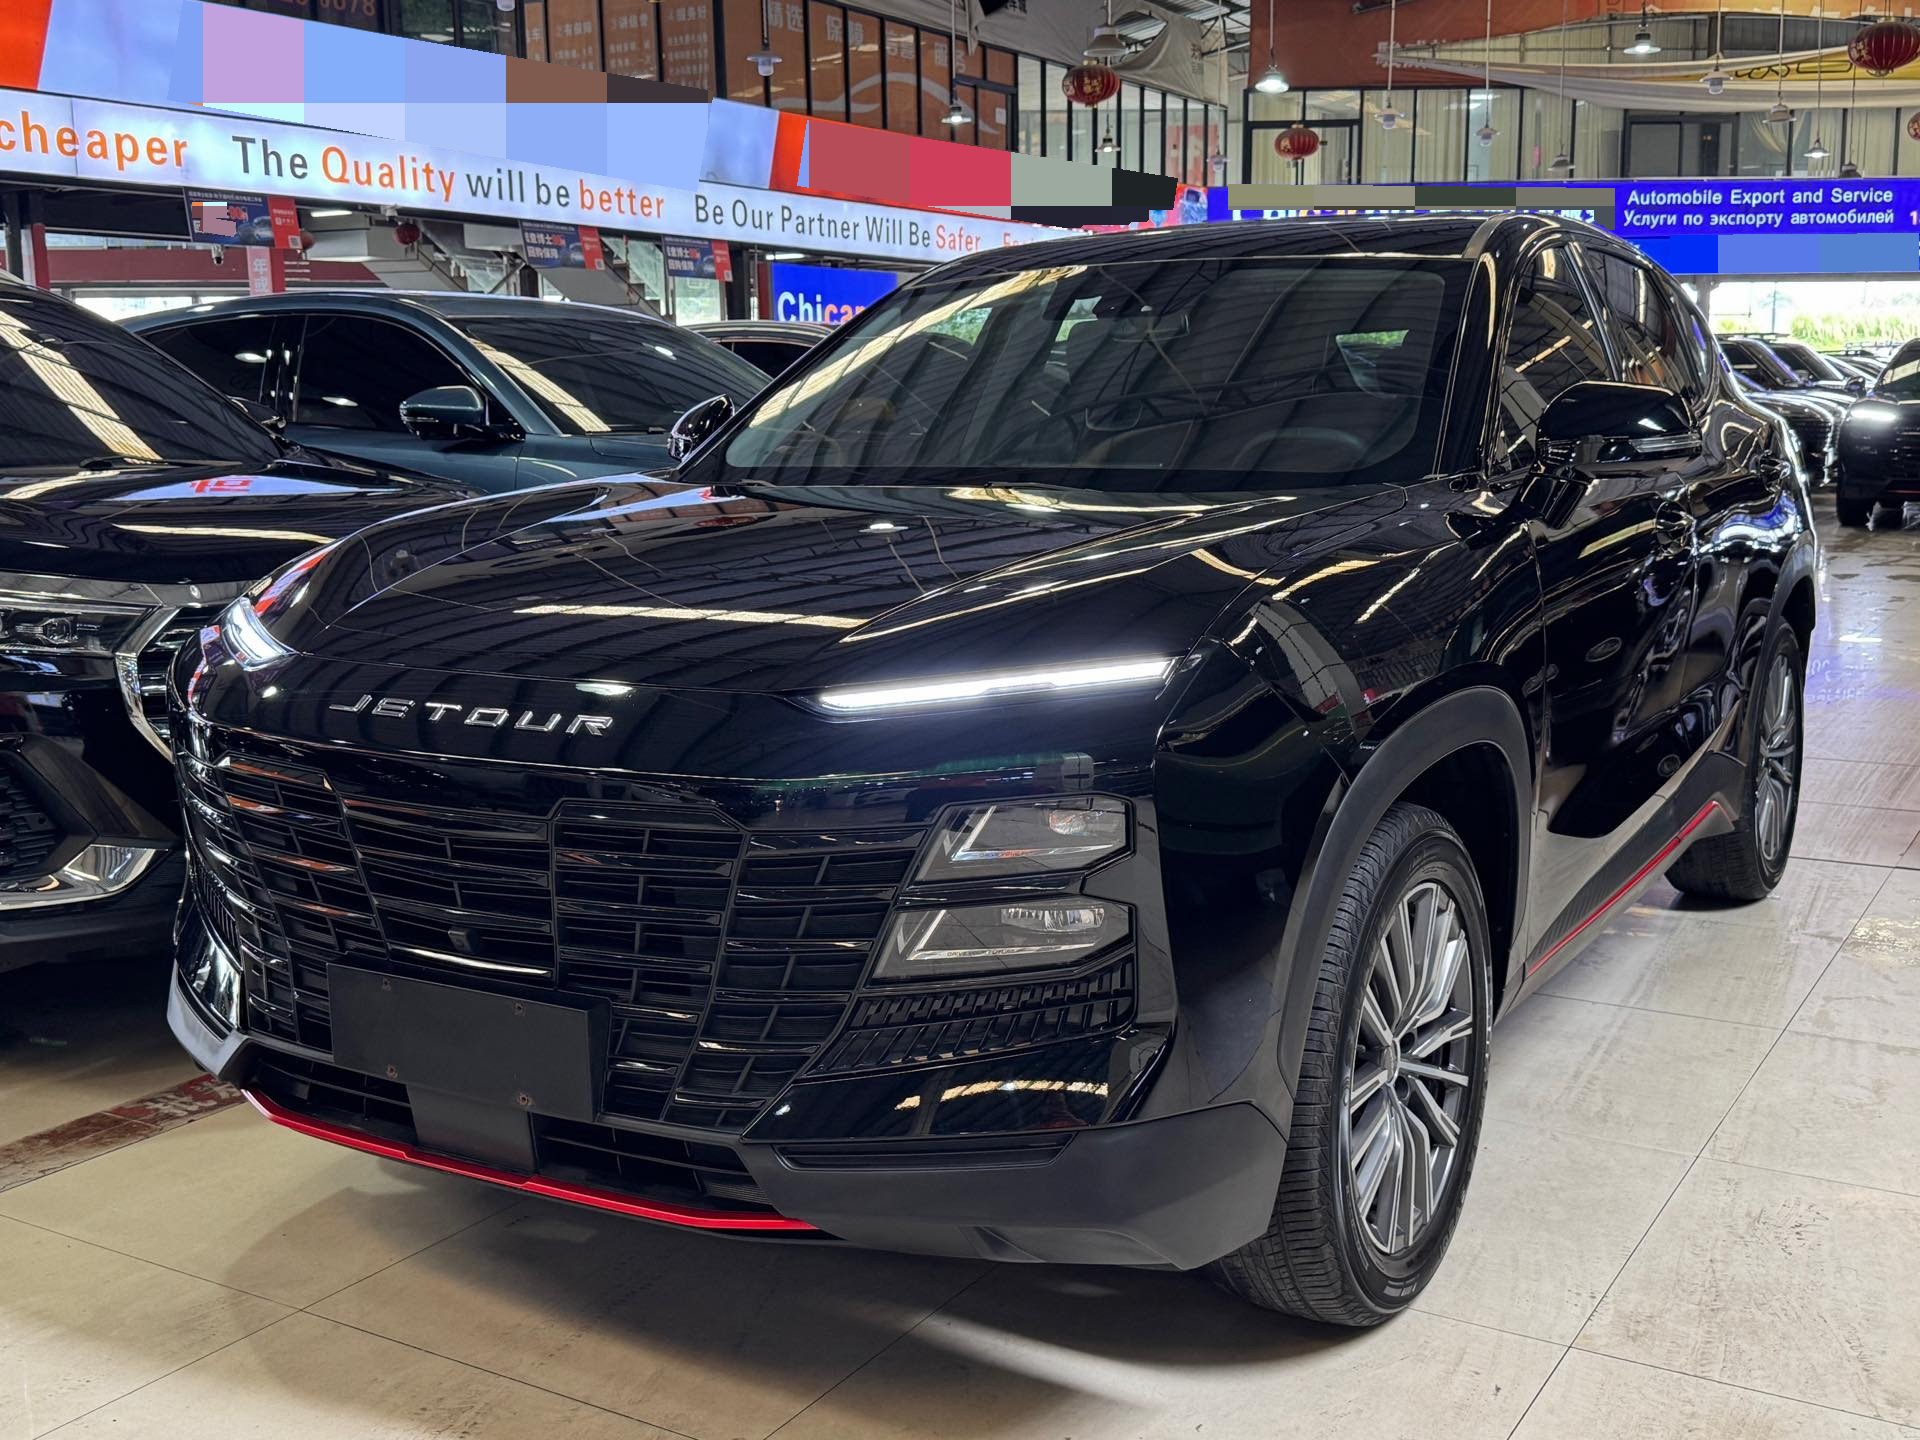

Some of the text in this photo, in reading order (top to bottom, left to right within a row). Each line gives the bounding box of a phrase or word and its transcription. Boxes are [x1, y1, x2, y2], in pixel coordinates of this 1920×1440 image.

[0, 110, 189, 171] cheaper
[231, 135, 309, 179] The
[321, 146, 455, 202] Quality
[465, 168, 525, 203] will
[535, 172, 570, 207] be
[579, 178, 664, 219] better
[695, 194, 724, 225] Be
[732, 199, 774, 232] Our
[781, 205, 860, 241] Partner
[865, 215, 903, 246] Will
[908, 221, 931, 248] Be
[936, 224, 982, 252] Safer
[1627, 187, 1894, 209] Automobile Export and Service
[1623, 207, 1895, 229] Услуги по экспорту автомобилей
[328, 693, 613, 737] JETOUR
